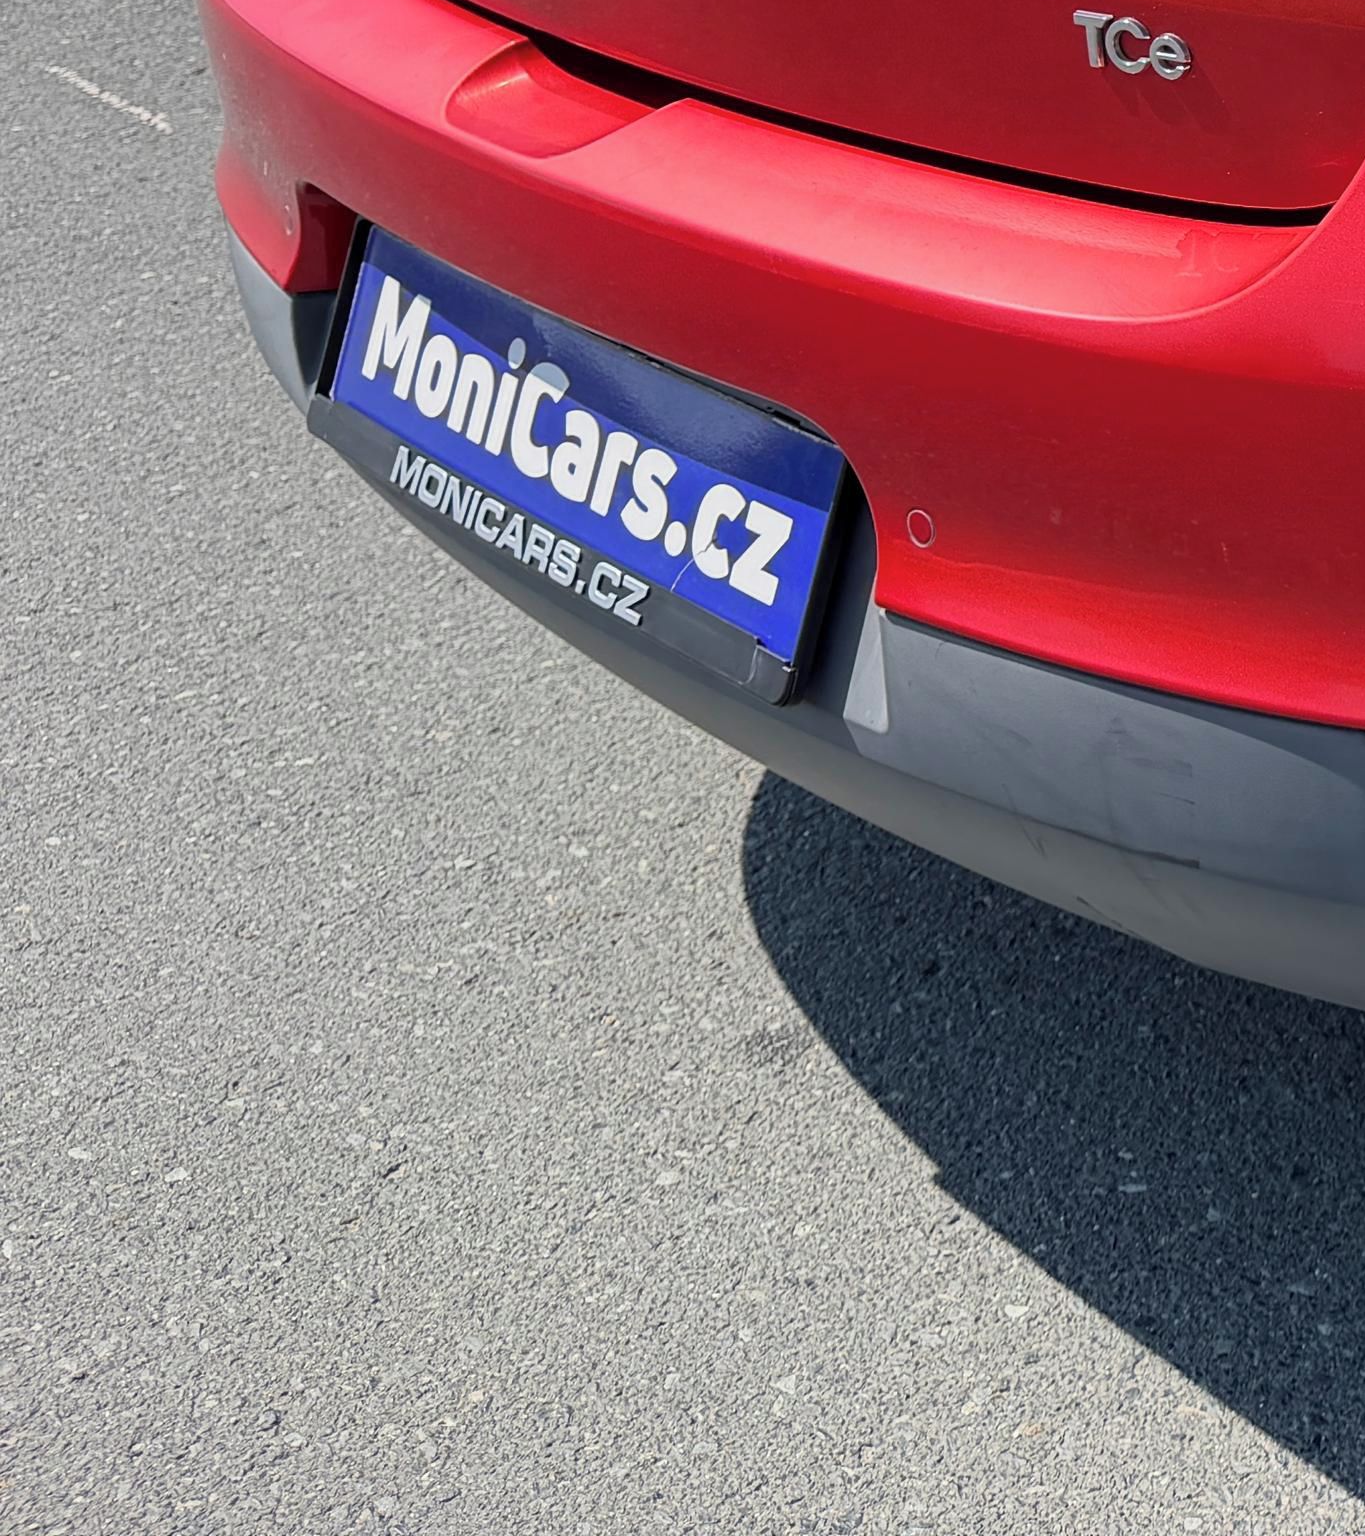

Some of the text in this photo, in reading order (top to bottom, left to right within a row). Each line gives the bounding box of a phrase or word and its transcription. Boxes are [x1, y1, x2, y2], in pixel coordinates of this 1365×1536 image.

[1073, 9, 1192, 81] TCe
[361, 275, 794, 607] MoniCars.cz
[389, 445, 652, 627] MONICARS.CZ
